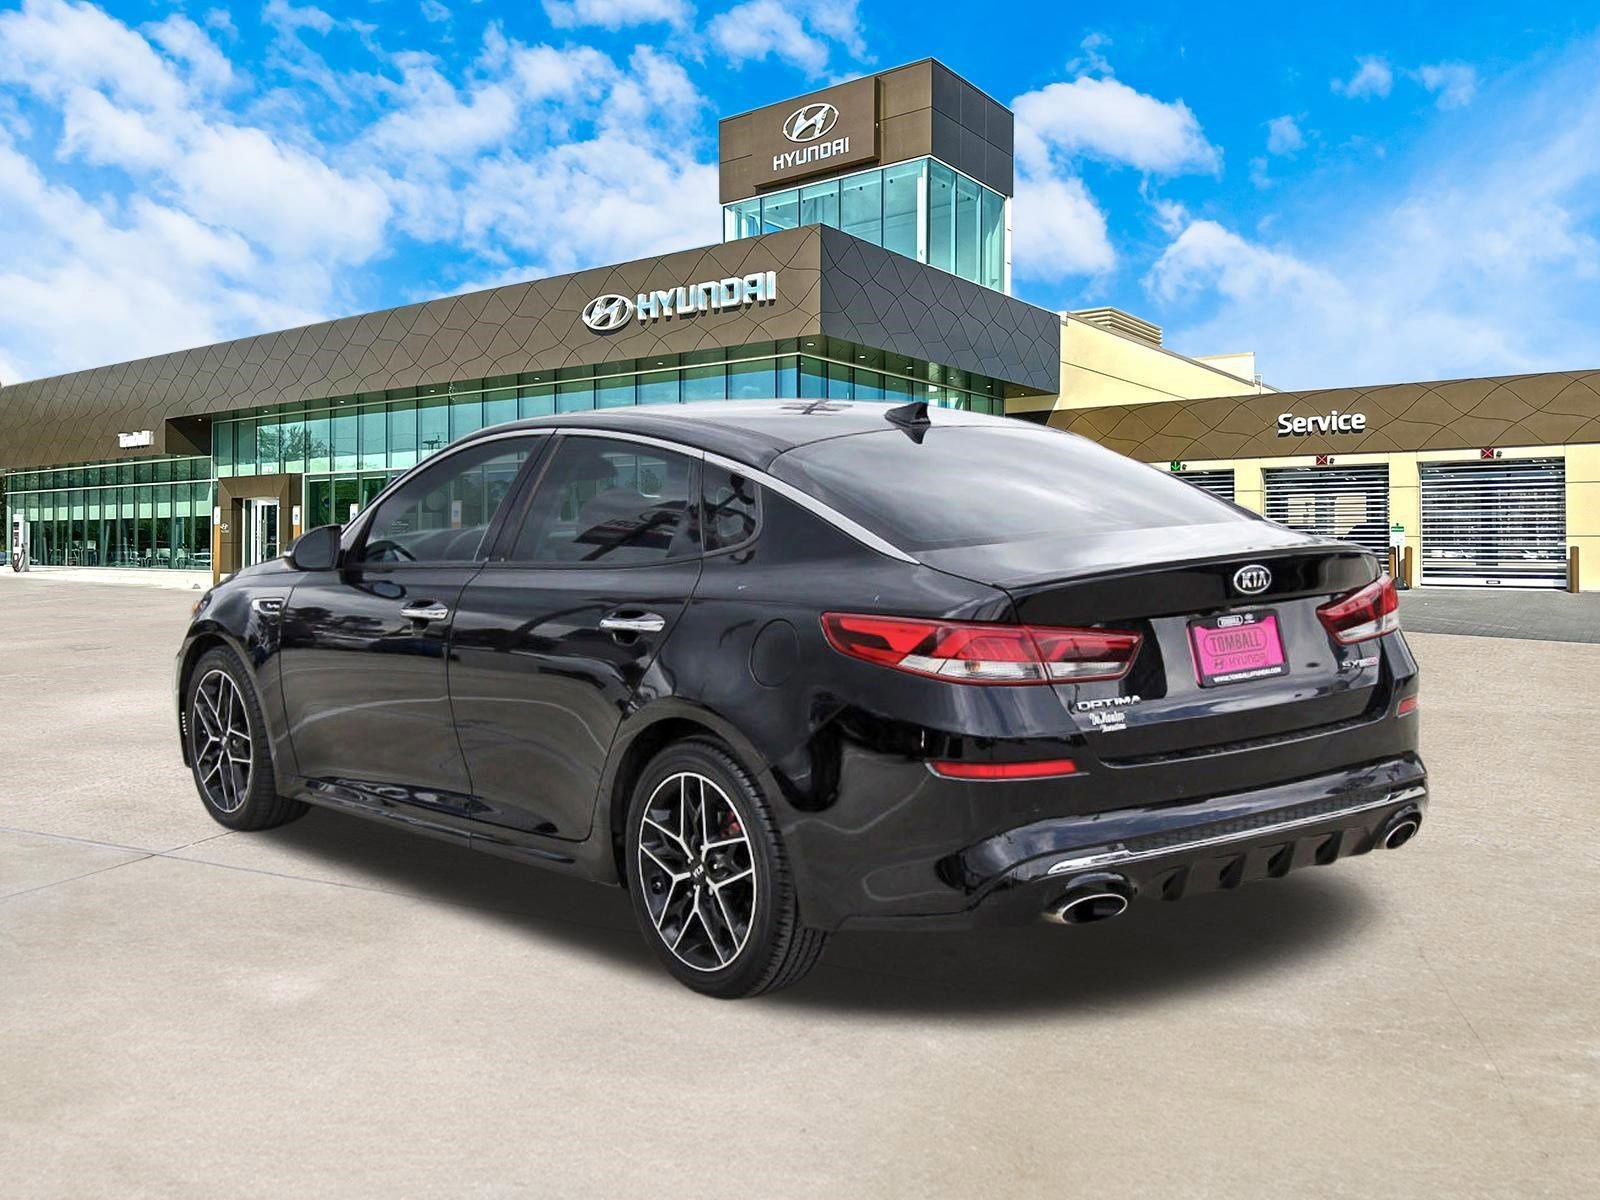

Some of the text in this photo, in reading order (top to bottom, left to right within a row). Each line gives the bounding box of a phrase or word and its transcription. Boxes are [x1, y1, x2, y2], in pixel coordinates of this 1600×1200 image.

[772, 136, 850, 171] HYUNDAI
[637, 271, 777, 321] HYUNDAI
[1277, 410, 1367, 434] Service
[1209, 630, 1262, 652] TOMBALL
[1076, 694, 1141, 711] OPTIMA
